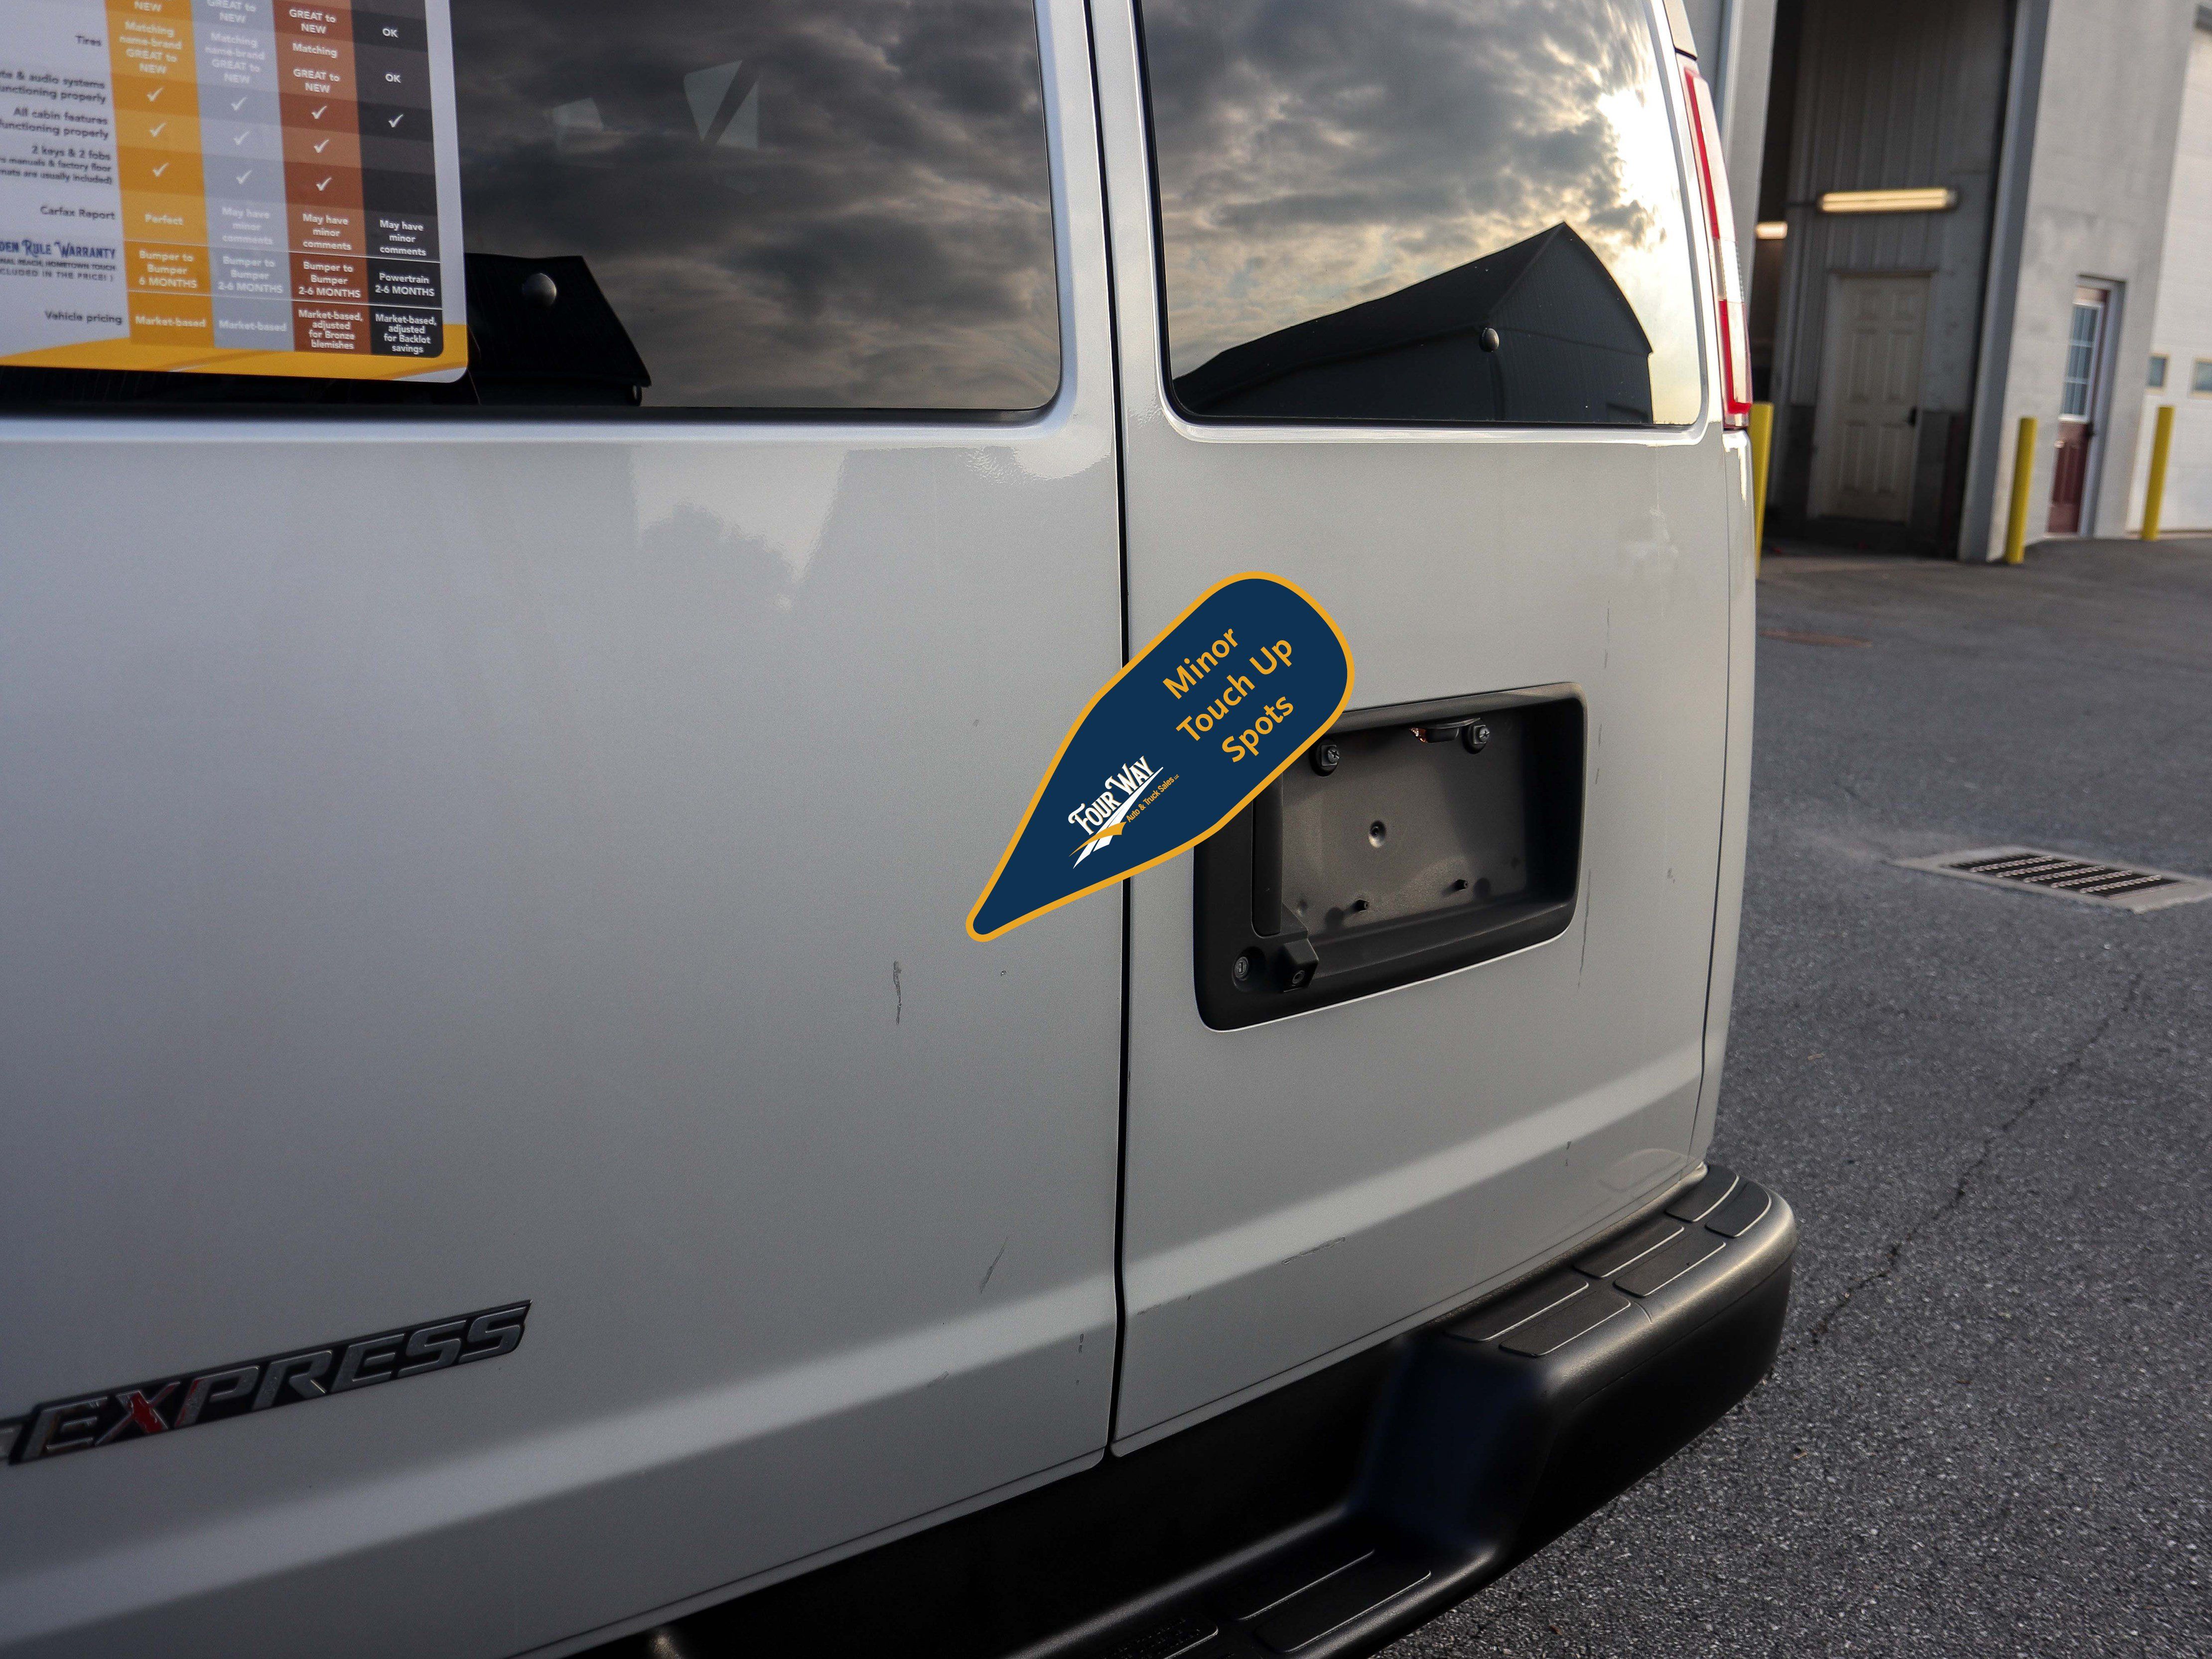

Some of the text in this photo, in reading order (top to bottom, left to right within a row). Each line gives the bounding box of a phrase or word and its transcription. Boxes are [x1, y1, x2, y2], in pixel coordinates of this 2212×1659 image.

[289, 9, 337, 23] GREAT to
[301, 23, 326, 34] NEW
[382, 27, 399, 38] OK
[75, 34, 102, 47] Tires
[292, 42, 338, 59] Matching
[29, 74, 59, 84] audio
[62, 78, 105, 89] systems
[293, 69, 341, 82] GREAT to
[385, 74, 401, 83] OK
[305, 82, 330, 93] NEW
[60, 92, 106, 105] properly
[13, 107, 28, 117] All
[64, 112, 108, 125] features
[64, 128, 108, 140] properly
[32, 145, 38, 154] 2
[40, 206, 115, 220] Carfax Report
[144, 213, 184, 225] Perfect
[302, 213, 349, 225] May have
[380, 220, 424, 231] May have
[312, 228, 340, 237] minor
[389, 234, 416, 243] minor
[302, 241, 352, 251] comments
[380, 247, 427, 256] comments
[138, 250, 194, 263] Bumper to
[147, 264, 188, 276] Bumper
[303, 261, 354, 273] Bumper to
[149, 277, 197, 289] MONTHS
[310, 274, 348, 285] Bumper
[379, 273, 430, 284] Powertrain
[316, 287, 362, 298] MONTHS
[375, 284, 435, 297] 2-6 MONTHS
[45, 311, 123, 326] Vehicle pricing
[298, 310, 364, 322] Market-based,
[375, 313, 437, 326] Market-based,
[312, 320, 352, 331] adjusted
[388, 324, 426, 335] adjusted
[308, 329, 356, 340] for Bronze
[384, 334, 431, 345] for Backlot
[311, 340, 355, 350] blemishes
[392, 344, 424, 355] savings
[21, 1306, 527, 1459] EXPRESS
